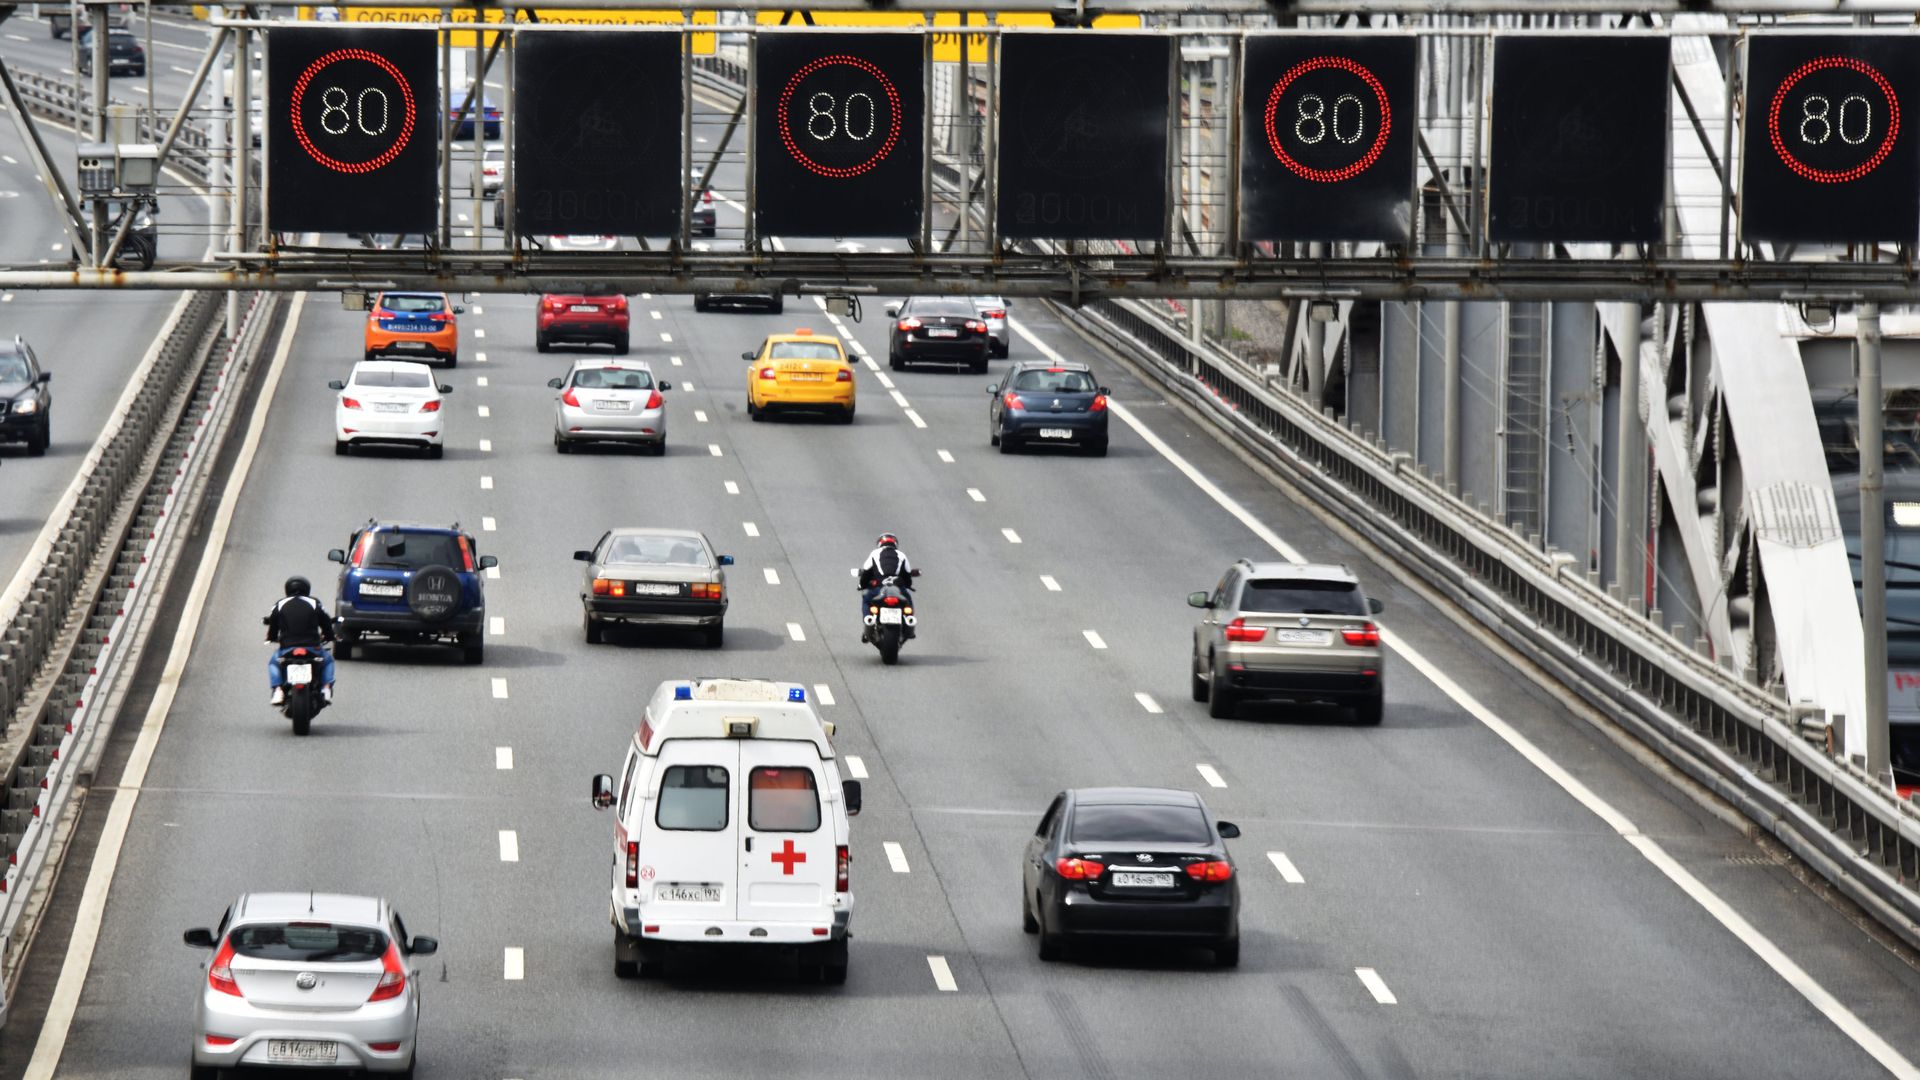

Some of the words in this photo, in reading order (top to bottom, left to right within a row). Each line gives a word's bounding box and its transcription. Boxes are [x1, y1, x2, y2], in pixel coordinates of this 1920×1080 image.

[321, 86, 388, 135] 80
[808, 91, 875, 141] 80
[1295, 92, 1364, 145] 80
[1800, 92, 1872, 145] 80
[418, 593, 453, 602] HONDA
